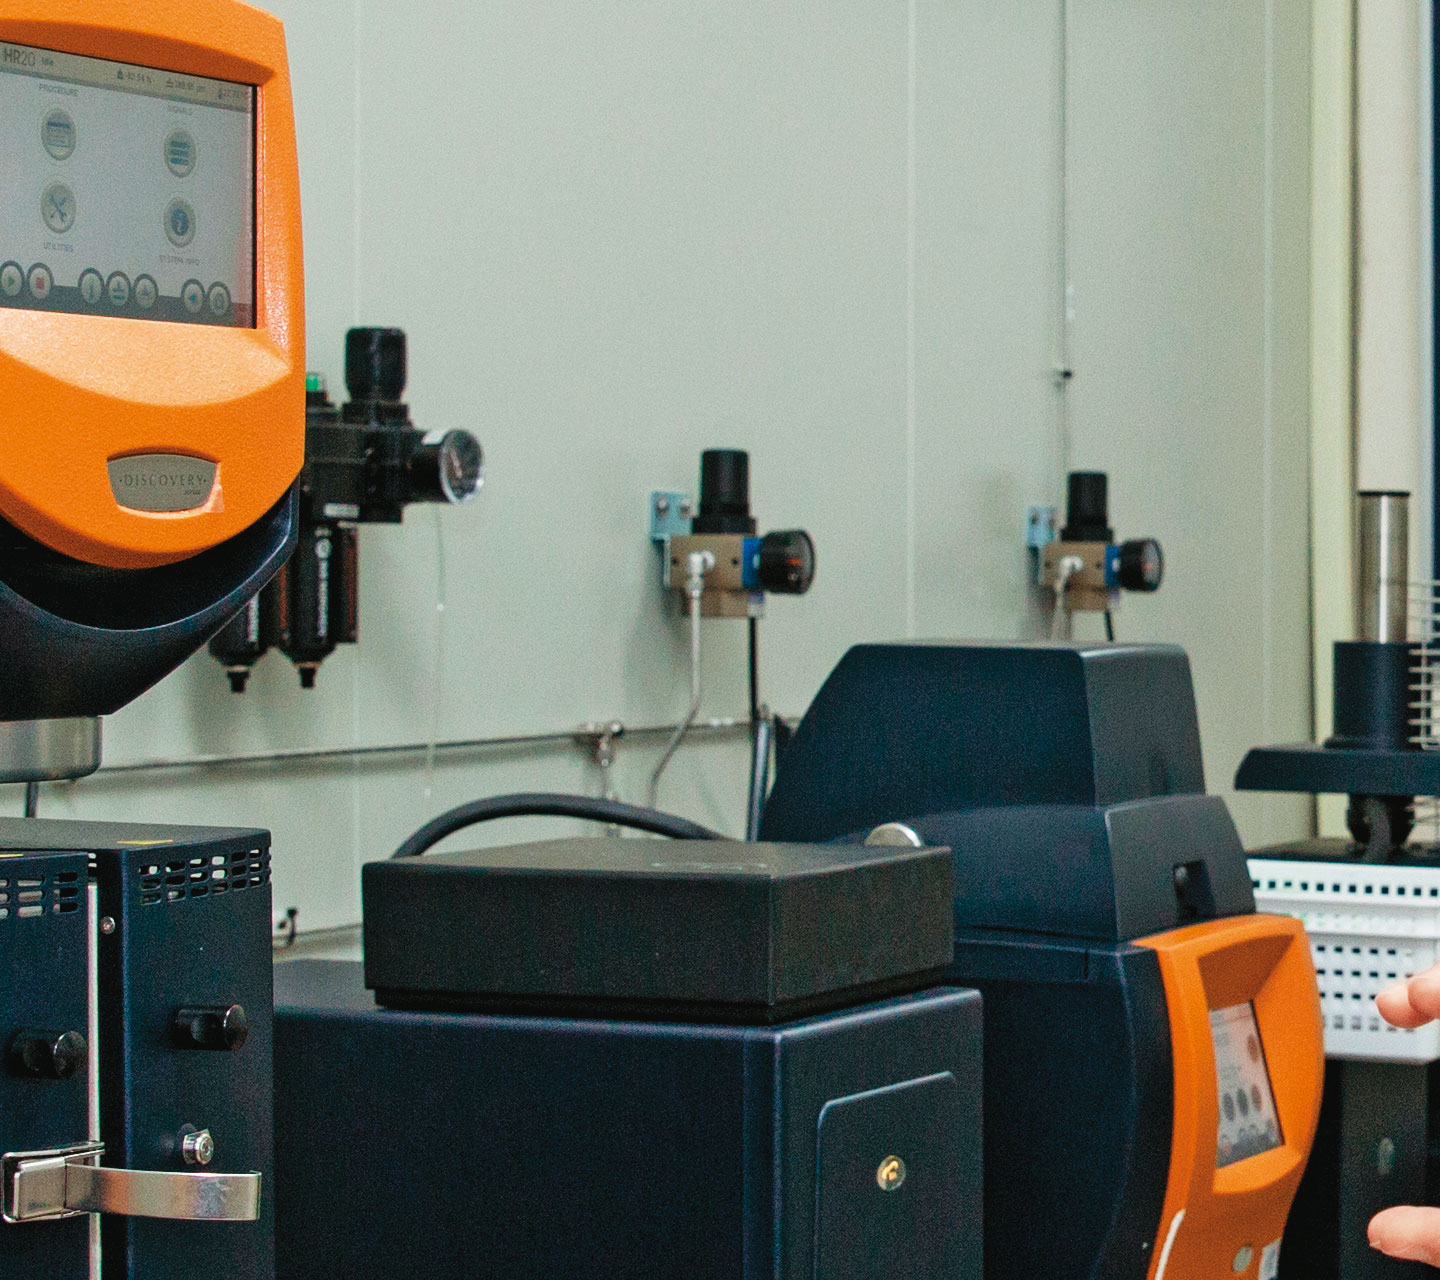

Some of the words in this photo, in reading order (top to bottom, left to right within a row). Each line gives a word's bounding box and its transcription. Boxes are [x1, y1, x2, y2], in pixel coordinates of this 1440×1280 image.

[4, 46, 36, 67] HR20
[39, 83, 78, 97] PROCEDURE
[123, 473, 204, 487] DISCOVERY
